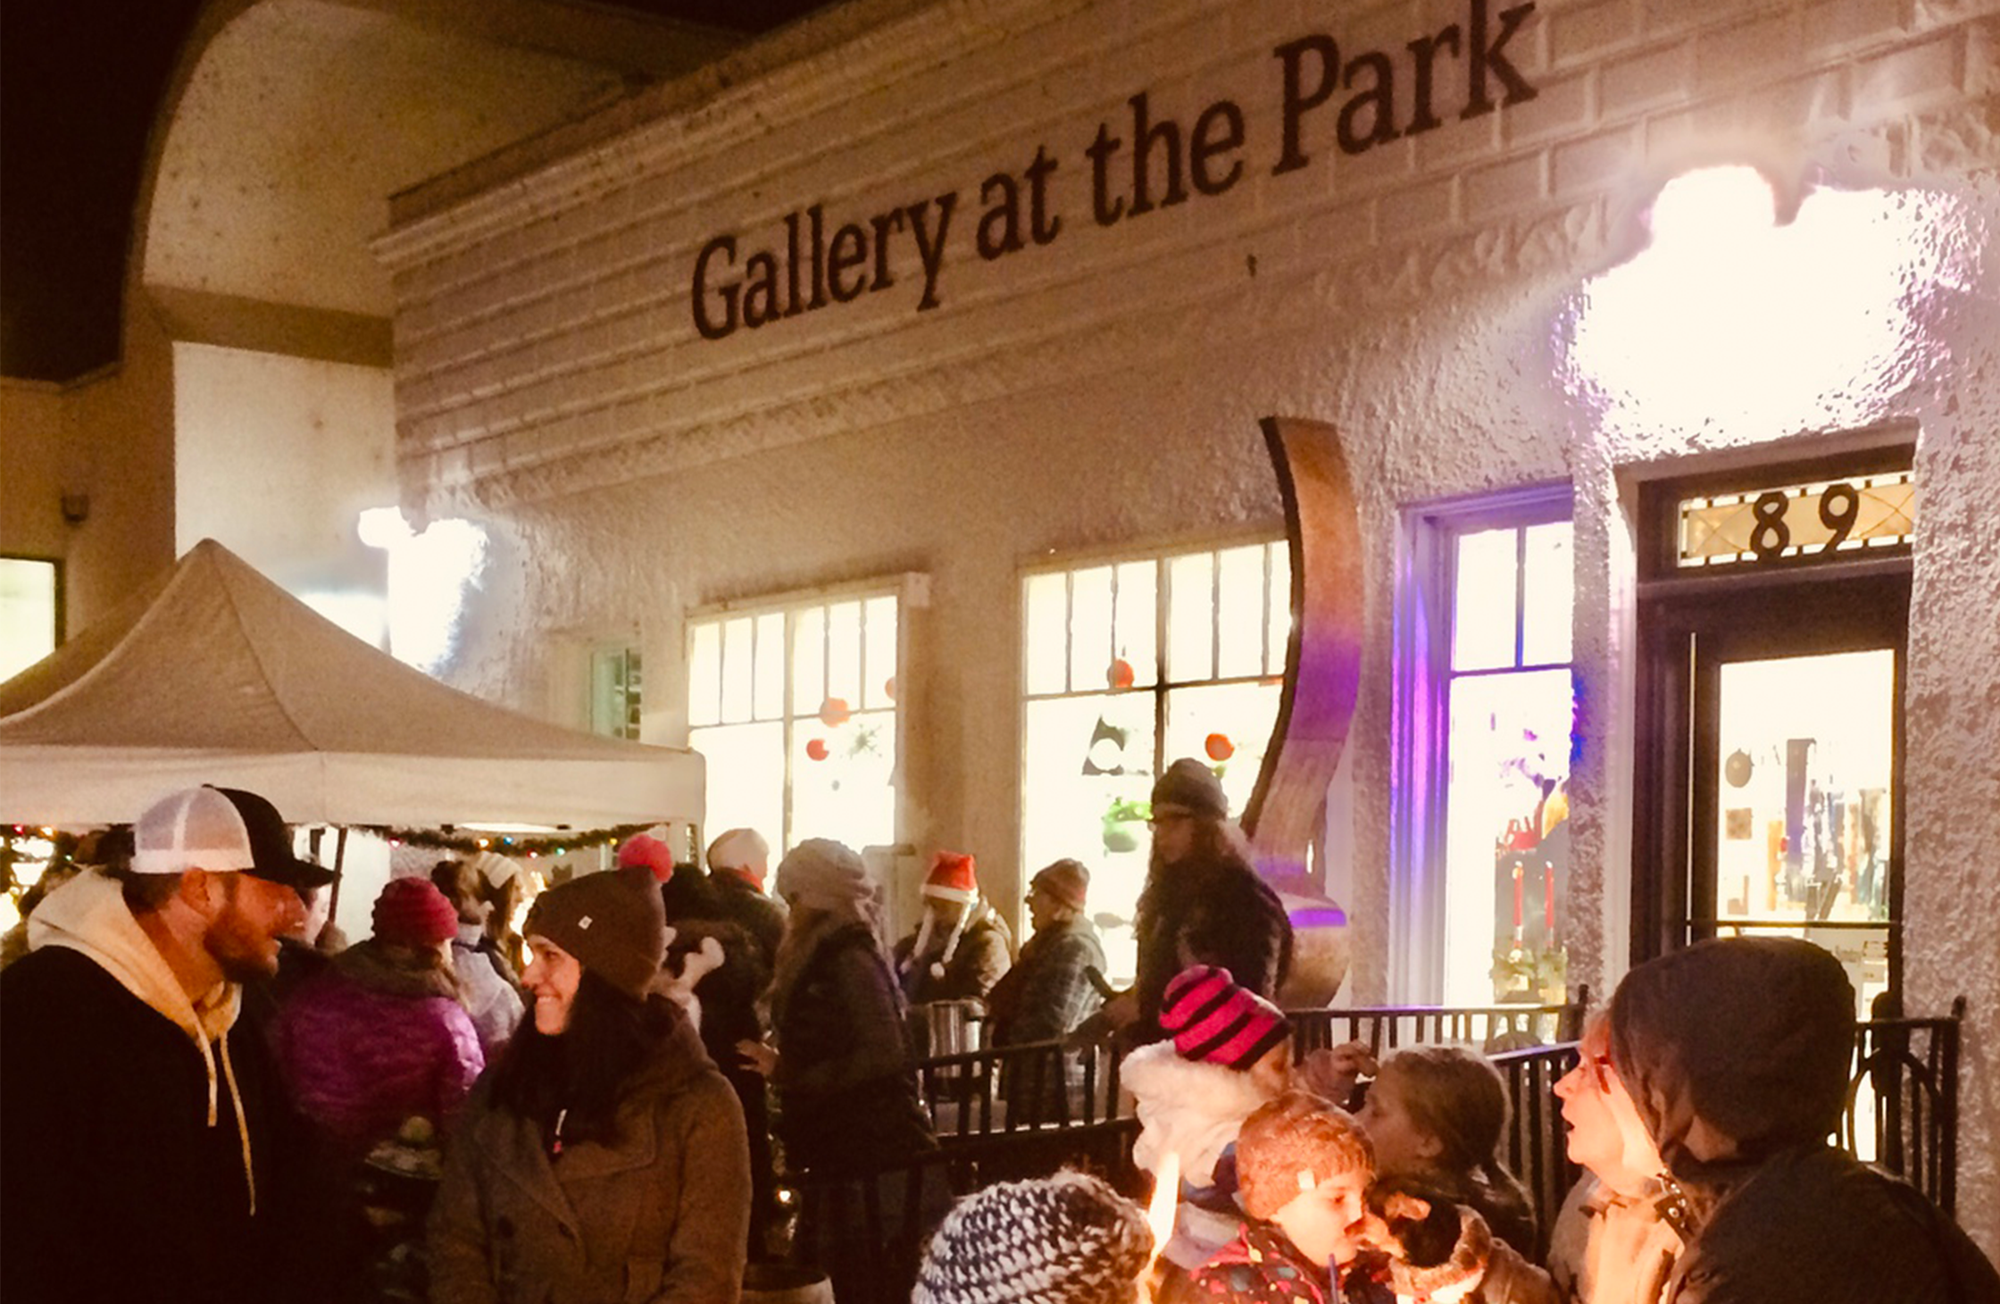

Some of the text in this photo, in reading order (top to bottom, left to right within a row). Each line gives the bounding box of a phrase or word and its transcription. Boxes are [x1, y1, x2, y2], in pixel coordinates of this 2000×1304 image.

[692, 0, 1539, 340] Gallery at the Park
[1750, 483, 1860, 558] 89
